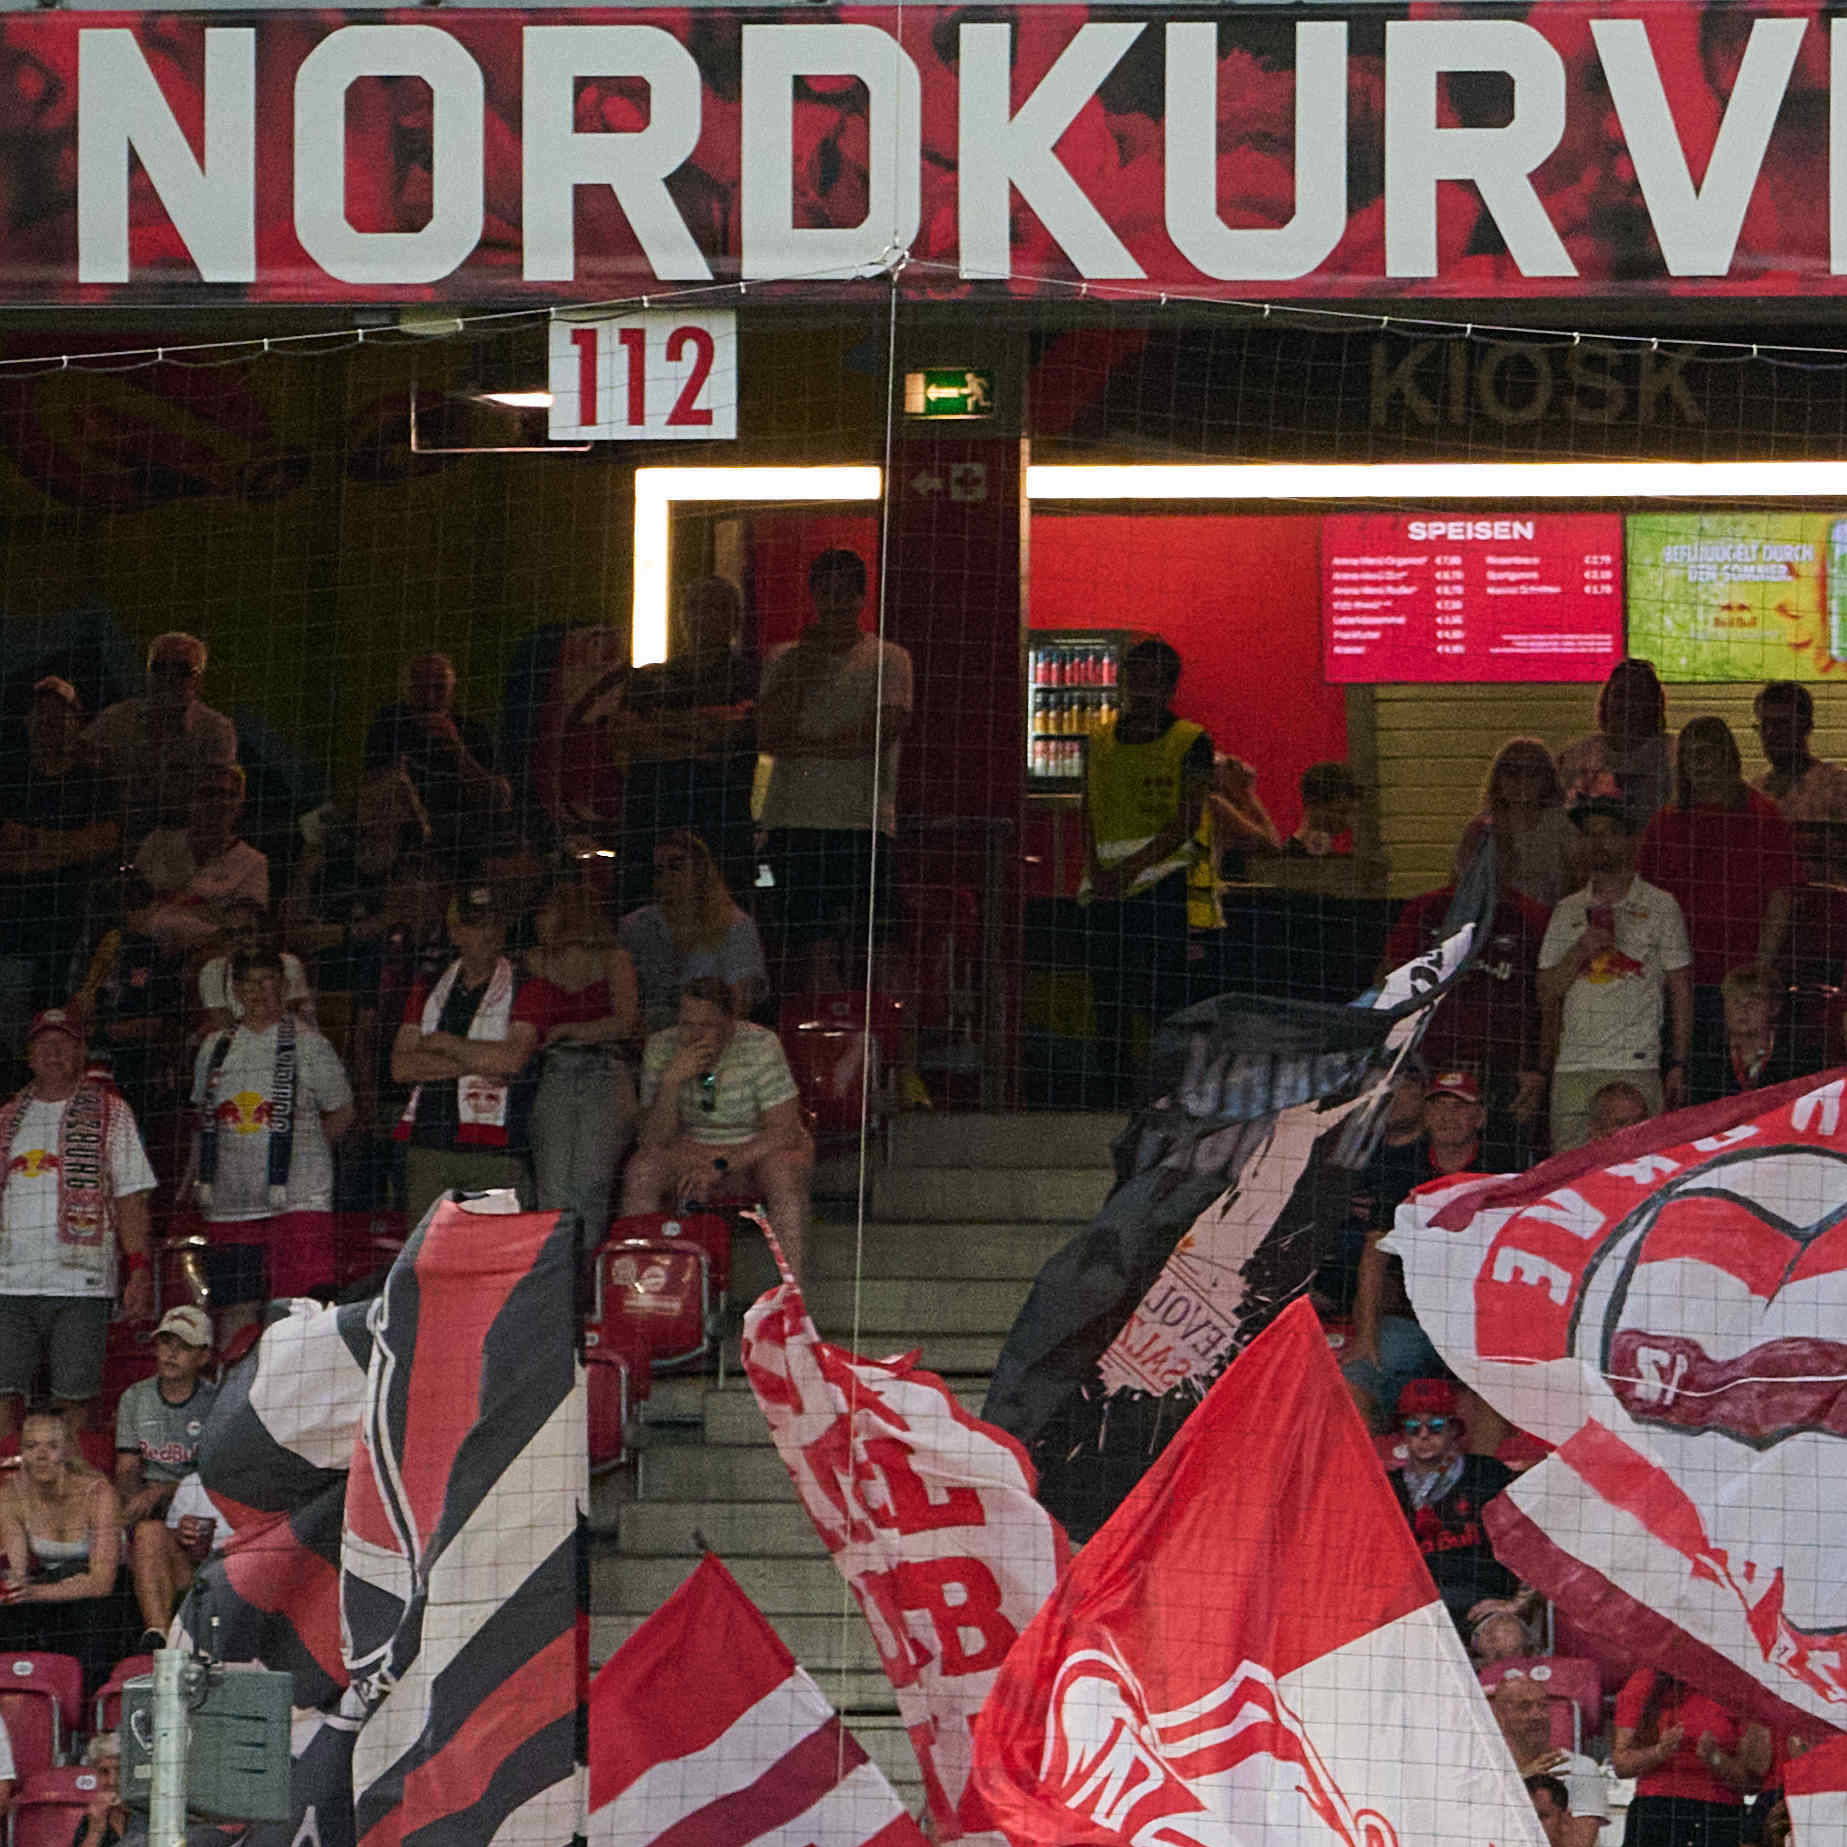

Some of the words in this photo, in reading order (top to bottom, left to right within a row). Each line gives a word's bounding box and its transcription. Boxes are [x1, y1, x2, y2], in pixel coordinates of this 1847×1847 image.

[570, 326, 716, 428] 112
[1370, 340, 1706, 426] KIOSK
[1407, 521, 1536, 541] SPEISEN
